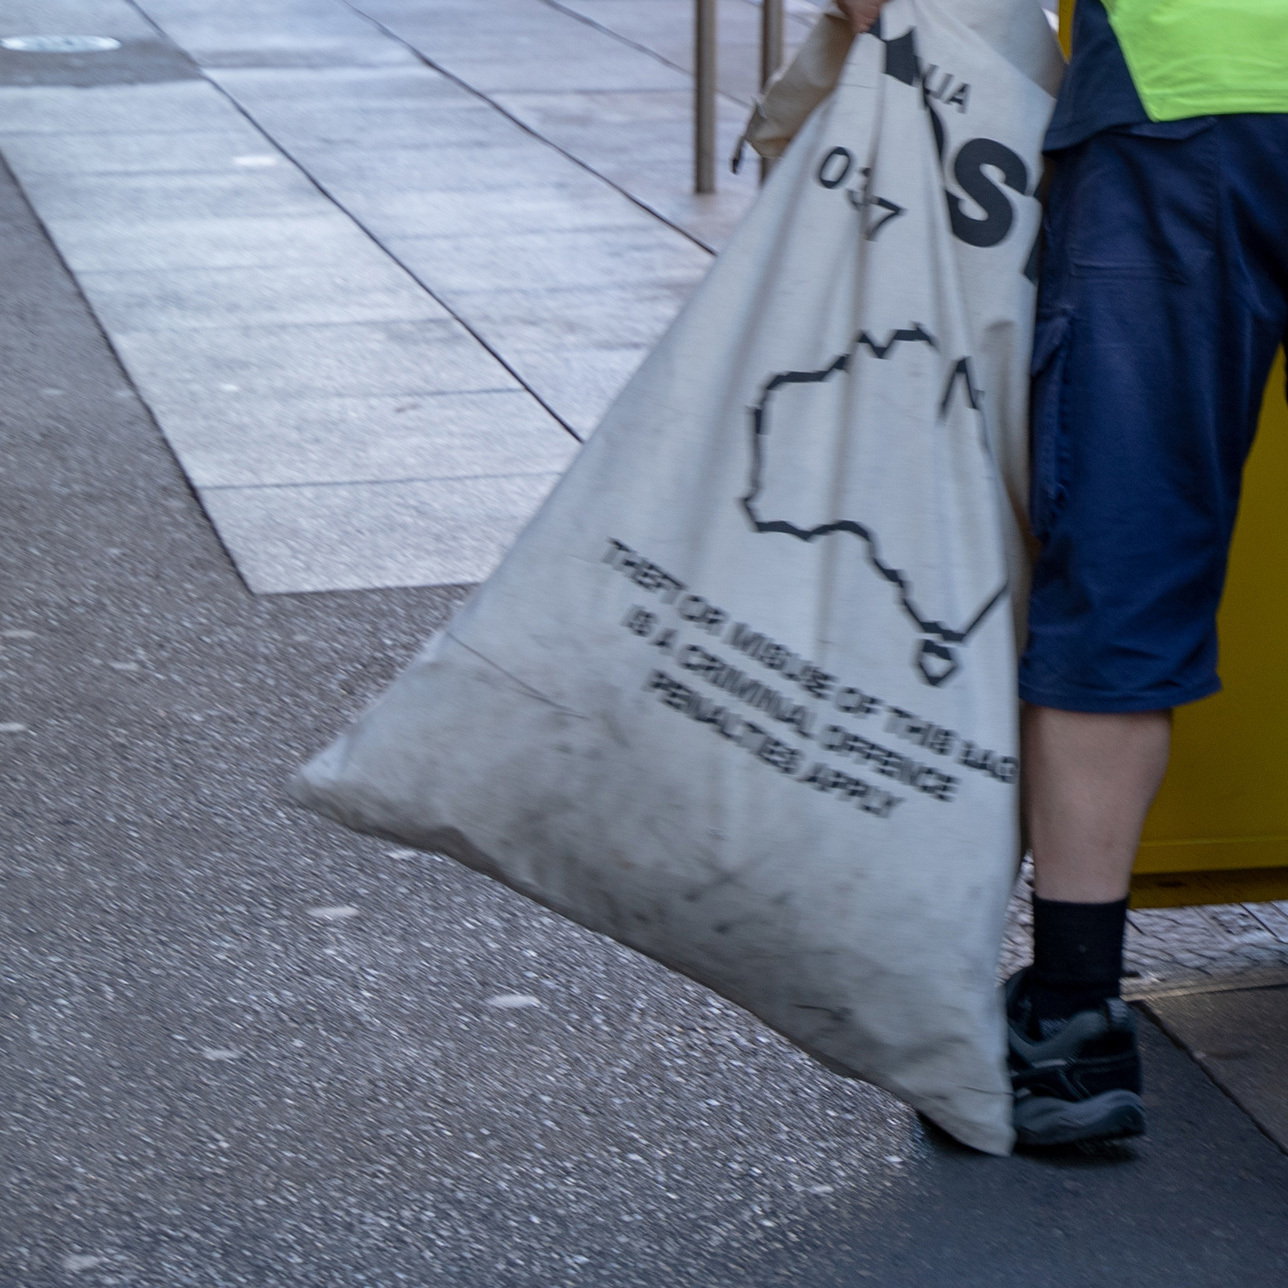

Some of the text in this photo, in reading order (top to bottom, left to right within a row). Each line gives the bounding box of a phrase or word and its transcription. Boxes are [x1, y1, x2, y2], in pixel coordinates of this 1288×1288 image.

[602, 536, 688, 604] THEFT
[678, 593, 728, 636] OR
[722, 620, 838, 701] MISUSE
[832, 686, 882, 719] OF
[881, 704, 959, 756] THIS
[621, 603, 962, 802] IS A CRIMINAL OFFENCE
[641, 667, 905, 818] PENALTIES APPLY
